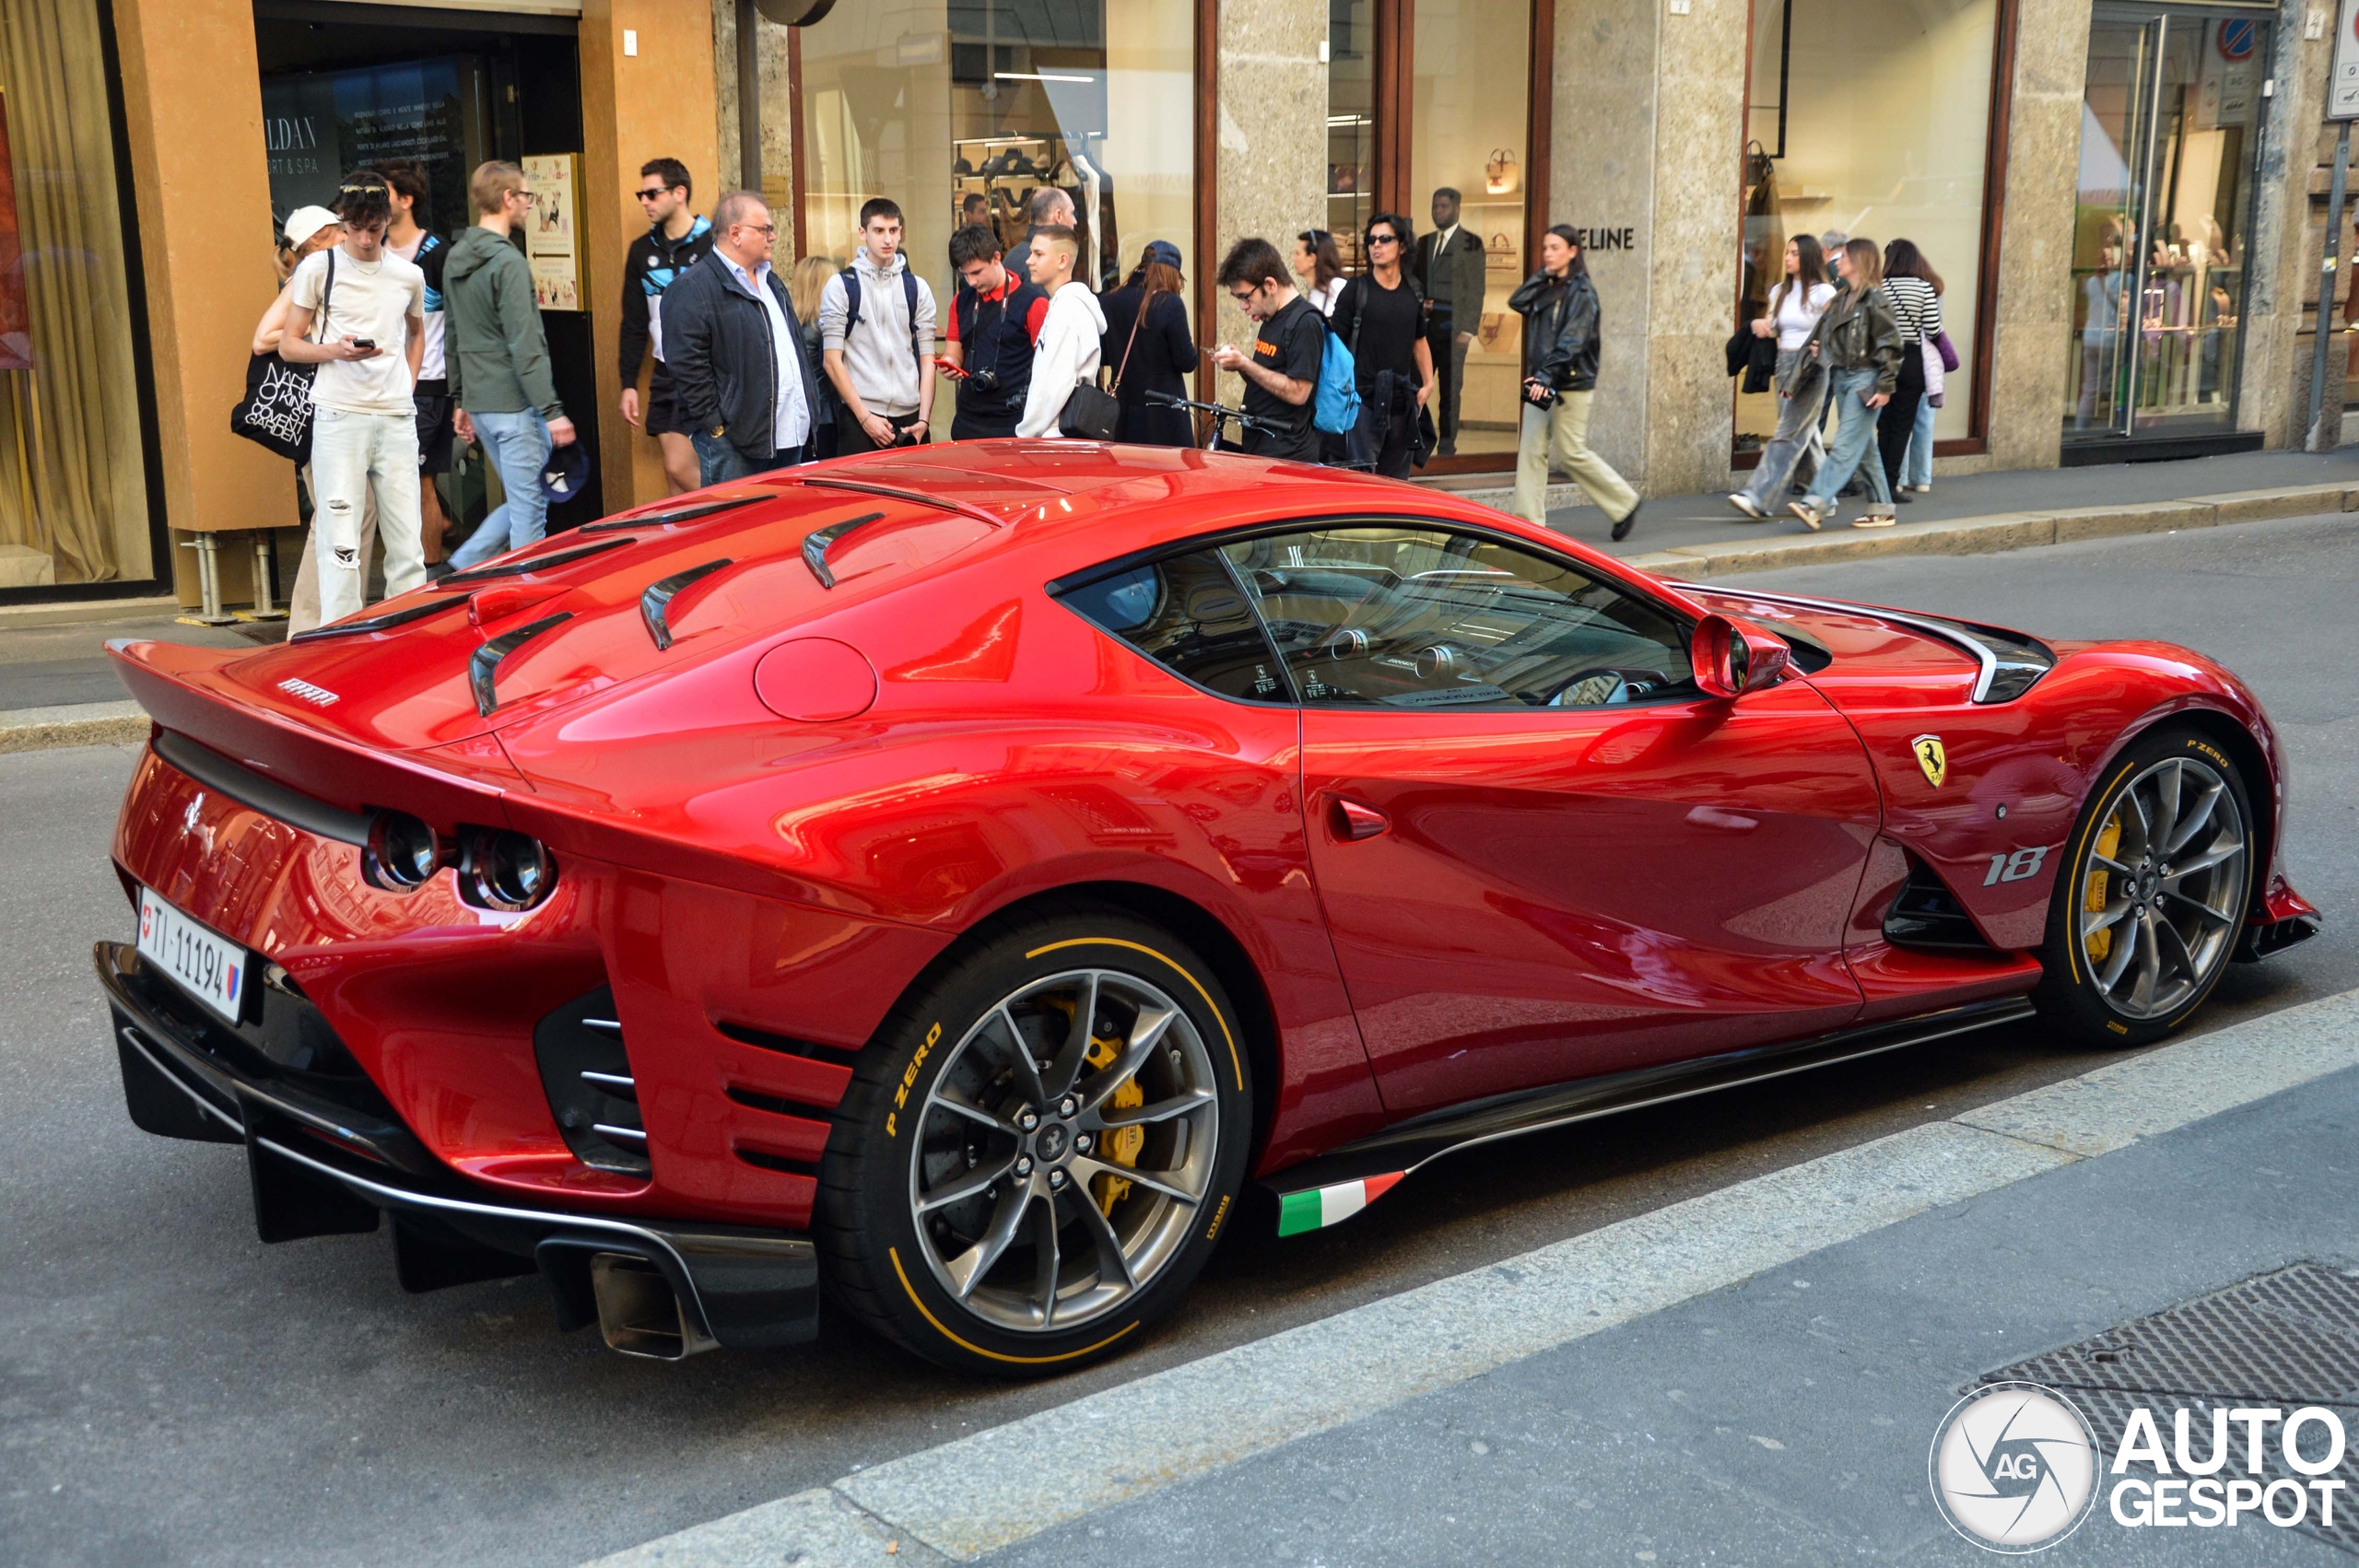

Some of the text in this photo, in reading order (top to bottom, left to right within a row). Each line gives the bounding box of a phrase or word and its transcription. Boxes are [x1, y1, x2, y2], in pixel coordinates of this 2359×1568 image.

[287, 158, 293, 175] &
[256, 382, 313, 416] 9 KING
[245, 414, 302, 446] GARDEN
[252, 403, 307, 434] COVENT
[2197, 742, 2228, 767] ZERO
[1982, 845, 2048, 887] 18
[176, 925, 223, 1000] 11194
[886, 1022, 942, 1137] P ZERO
